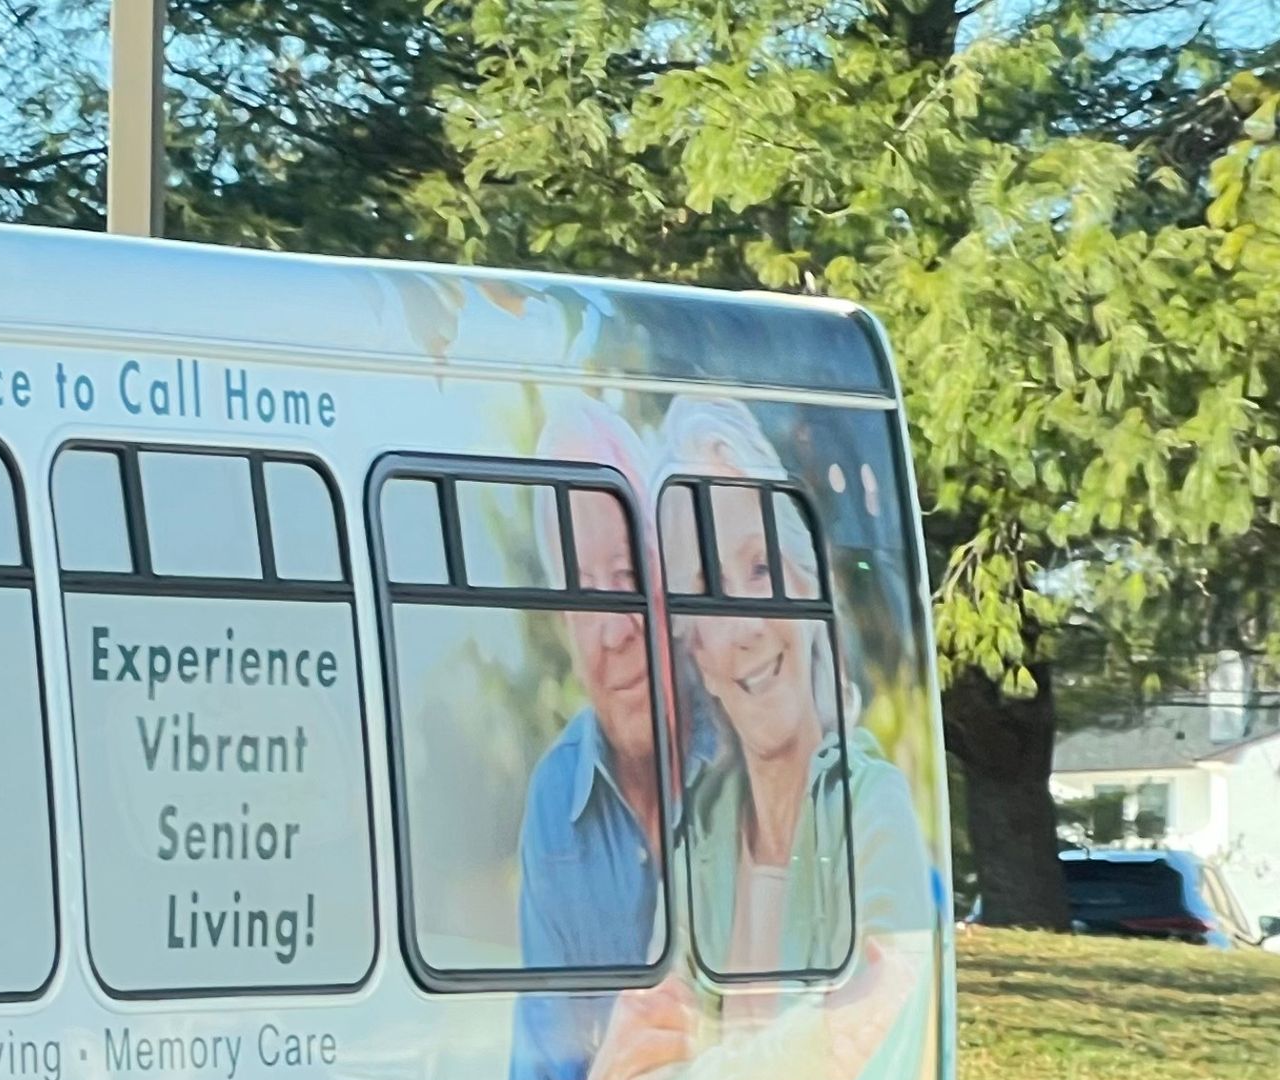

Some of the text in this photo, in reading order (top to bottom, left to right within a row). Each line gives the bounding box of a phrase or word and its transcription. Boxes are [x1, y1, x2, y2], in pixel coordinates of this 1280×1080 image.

[56, 361, 95, 412] to
[118, 357, 203, 418] Call
[225, 367, 337, 428] Home
[91, 625, 339, 701] Experience
[135, 711, 309, 773] Vibrant
[156, 802, 301, 861] Senior
[167, 890, 315, 965] Living!
[103, 1027, 242, 1079] Memory
[257, 1023, 338, 1068] Care
